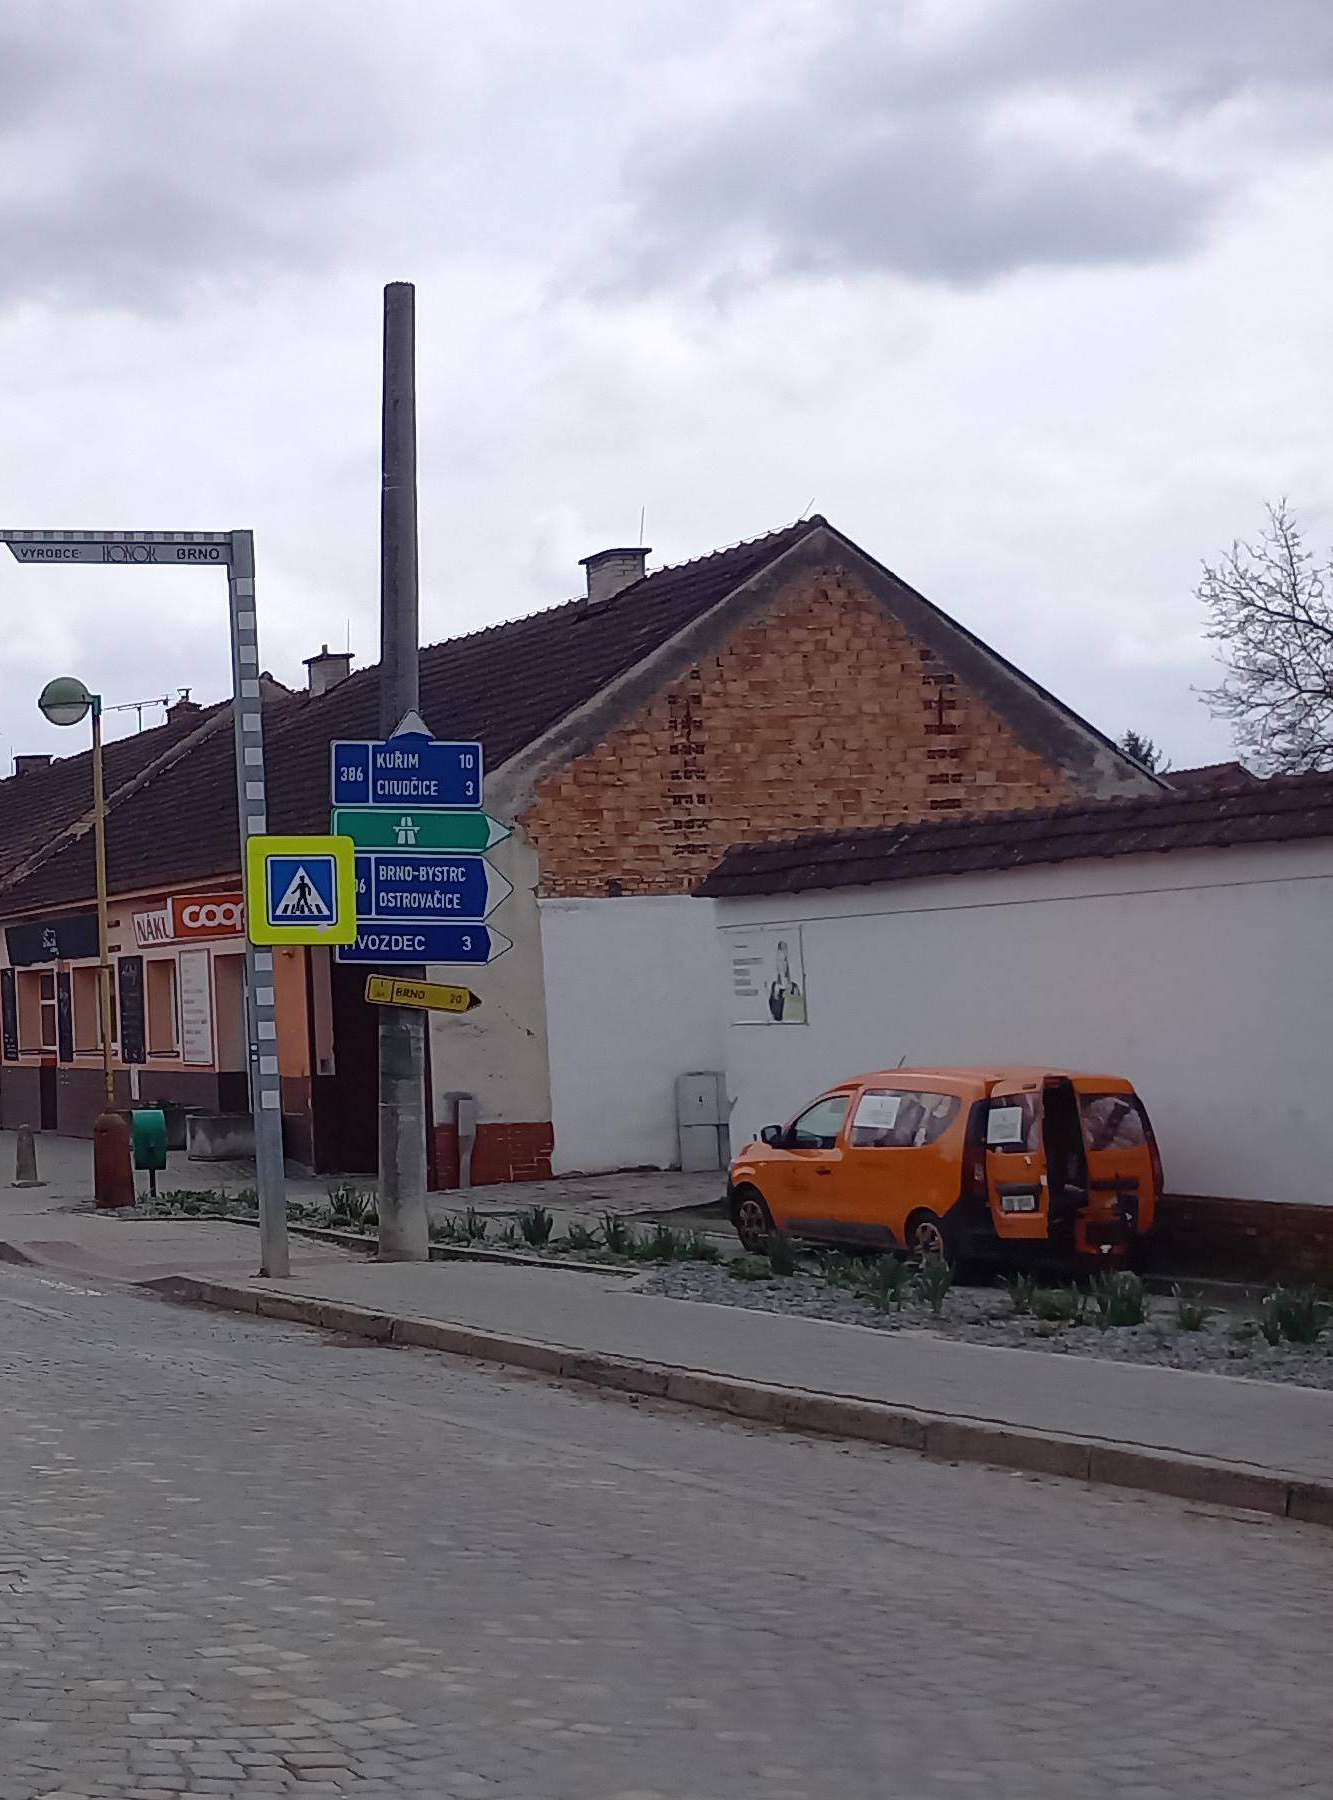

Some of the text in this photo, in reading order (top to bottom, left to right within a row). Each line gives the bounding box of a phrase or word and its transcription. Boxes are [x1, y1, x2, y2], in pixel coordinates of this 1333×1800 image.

[176, 548, 220, 560] BRNO
[376, 750, 474, 769] KUŘIM 10
[340, 766, 364, 782] 386
[465, 780, 474, 796] 3
[378, 865, 467, 882] BRNO-BYSTRC
[378, 889, 462, 909] OSTROVAČICE
[461, 935, 472, 951] 3
[395, 987, 426, 1000] BRNO
